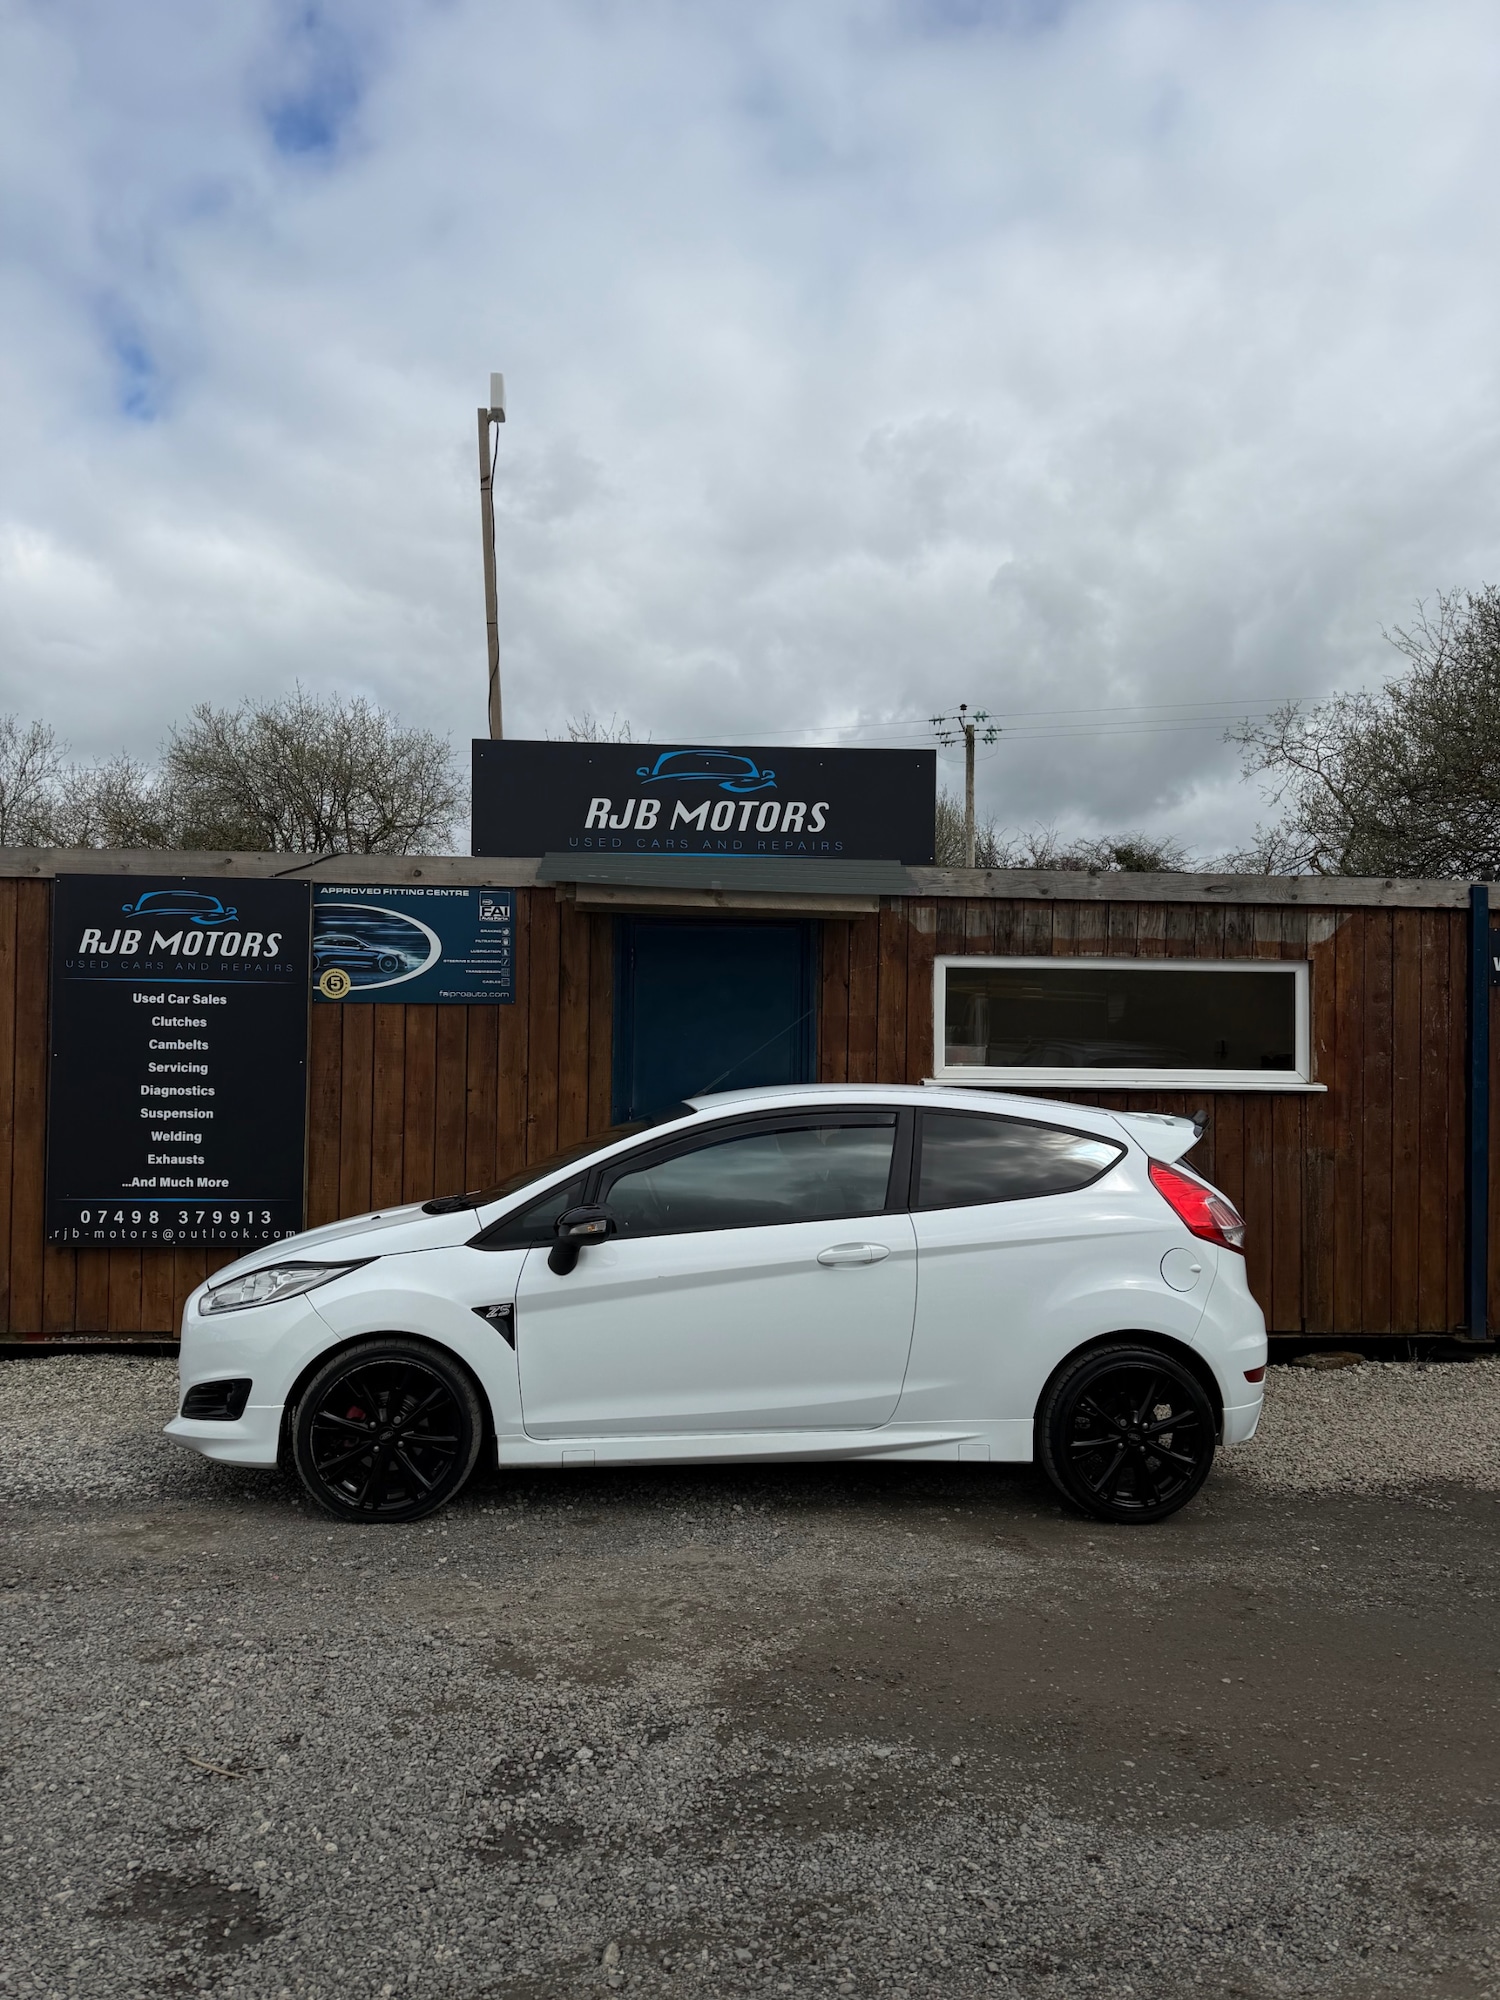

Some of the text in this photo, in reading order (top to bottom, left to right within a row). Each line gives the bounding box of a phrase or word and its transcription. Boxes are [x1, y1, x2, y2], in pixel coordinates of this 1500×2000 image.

[584, 798, 830, 832] RJB MOTORS
[569, 837, 844, 851] USED CARS AND REPAIRS
[320, 887, 469, 897] APPROVED FITTING CENTRE
[482, 906, 508, 916] FAI
[78, 928, 283, 957] RJB MOTORS
[65, 960, 294, 972] USED CARS AND REPAIRS
[330, 976, 340, 990] 5
[133, 993, 227, 1005] Used Car Sales
[439, 990, 509, 998] faiproauto.com
[151, 1016, 207, 1028] Clutches
[149, 1039, 209, 1050] Cambelts
[148, 1062, 209, 1075] Servicing
[140, 1085, 215, 1098] Diagnostics
[140, 1108, 214, 1120] Suspension
[151, 1131, 202, 1144] Welding
[147, 1154, 205, 1165] Exhausts
[121, 1177, 229, 1188] ...And Much More
[80, 1210, 272, 1224] 07498 379913
[54, 1227, 296, 1241] rjb-motors@outlook.com
[485, 1304, 512, 1318] ZS
